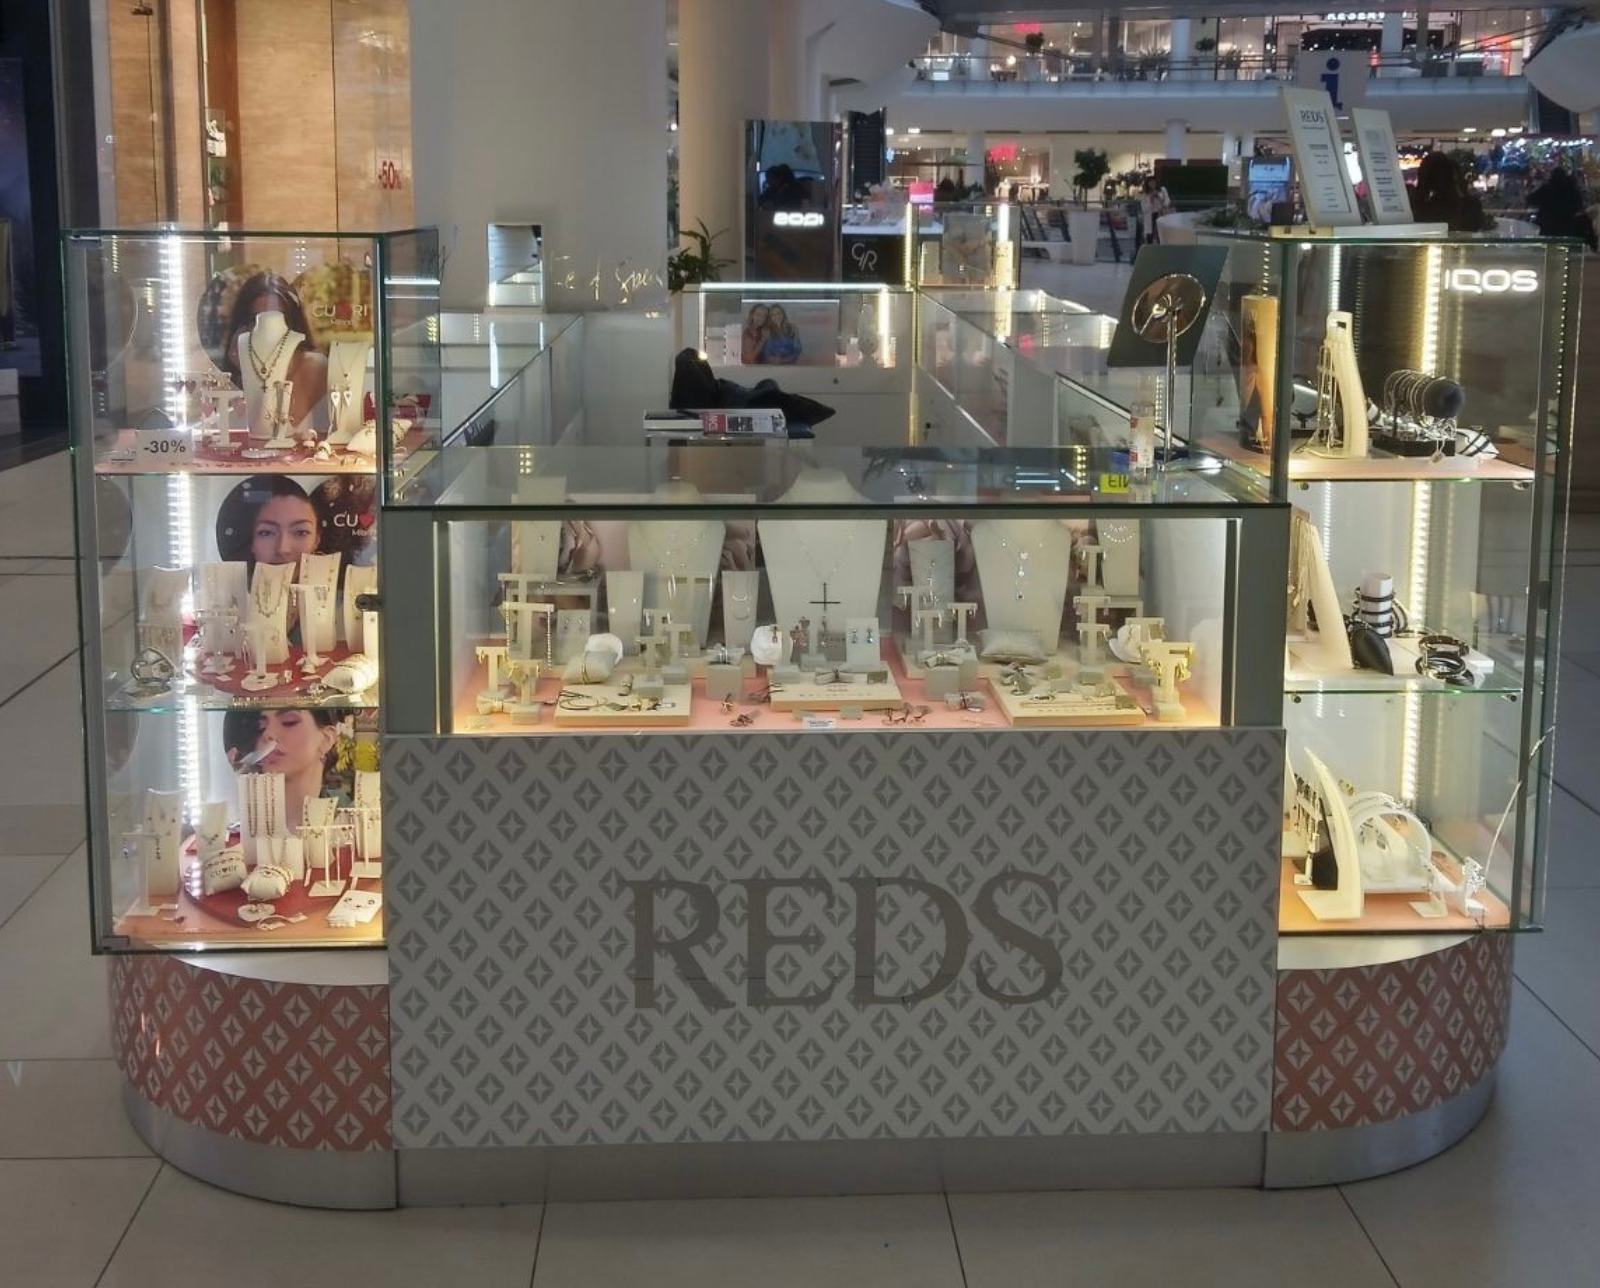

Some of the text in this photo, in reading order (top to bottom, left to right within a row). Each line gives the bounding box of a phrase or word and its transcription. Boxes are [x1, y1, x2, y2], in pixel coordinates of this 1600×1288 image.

[1327, 11, 1407, 21] RESERV
[1300, 110, 1325, 122] REDS
[1444, 268, 1538, 295] IQOS
[143, 440, 186, 454] -30%
[620, 870, 1064, 1009] REDS
